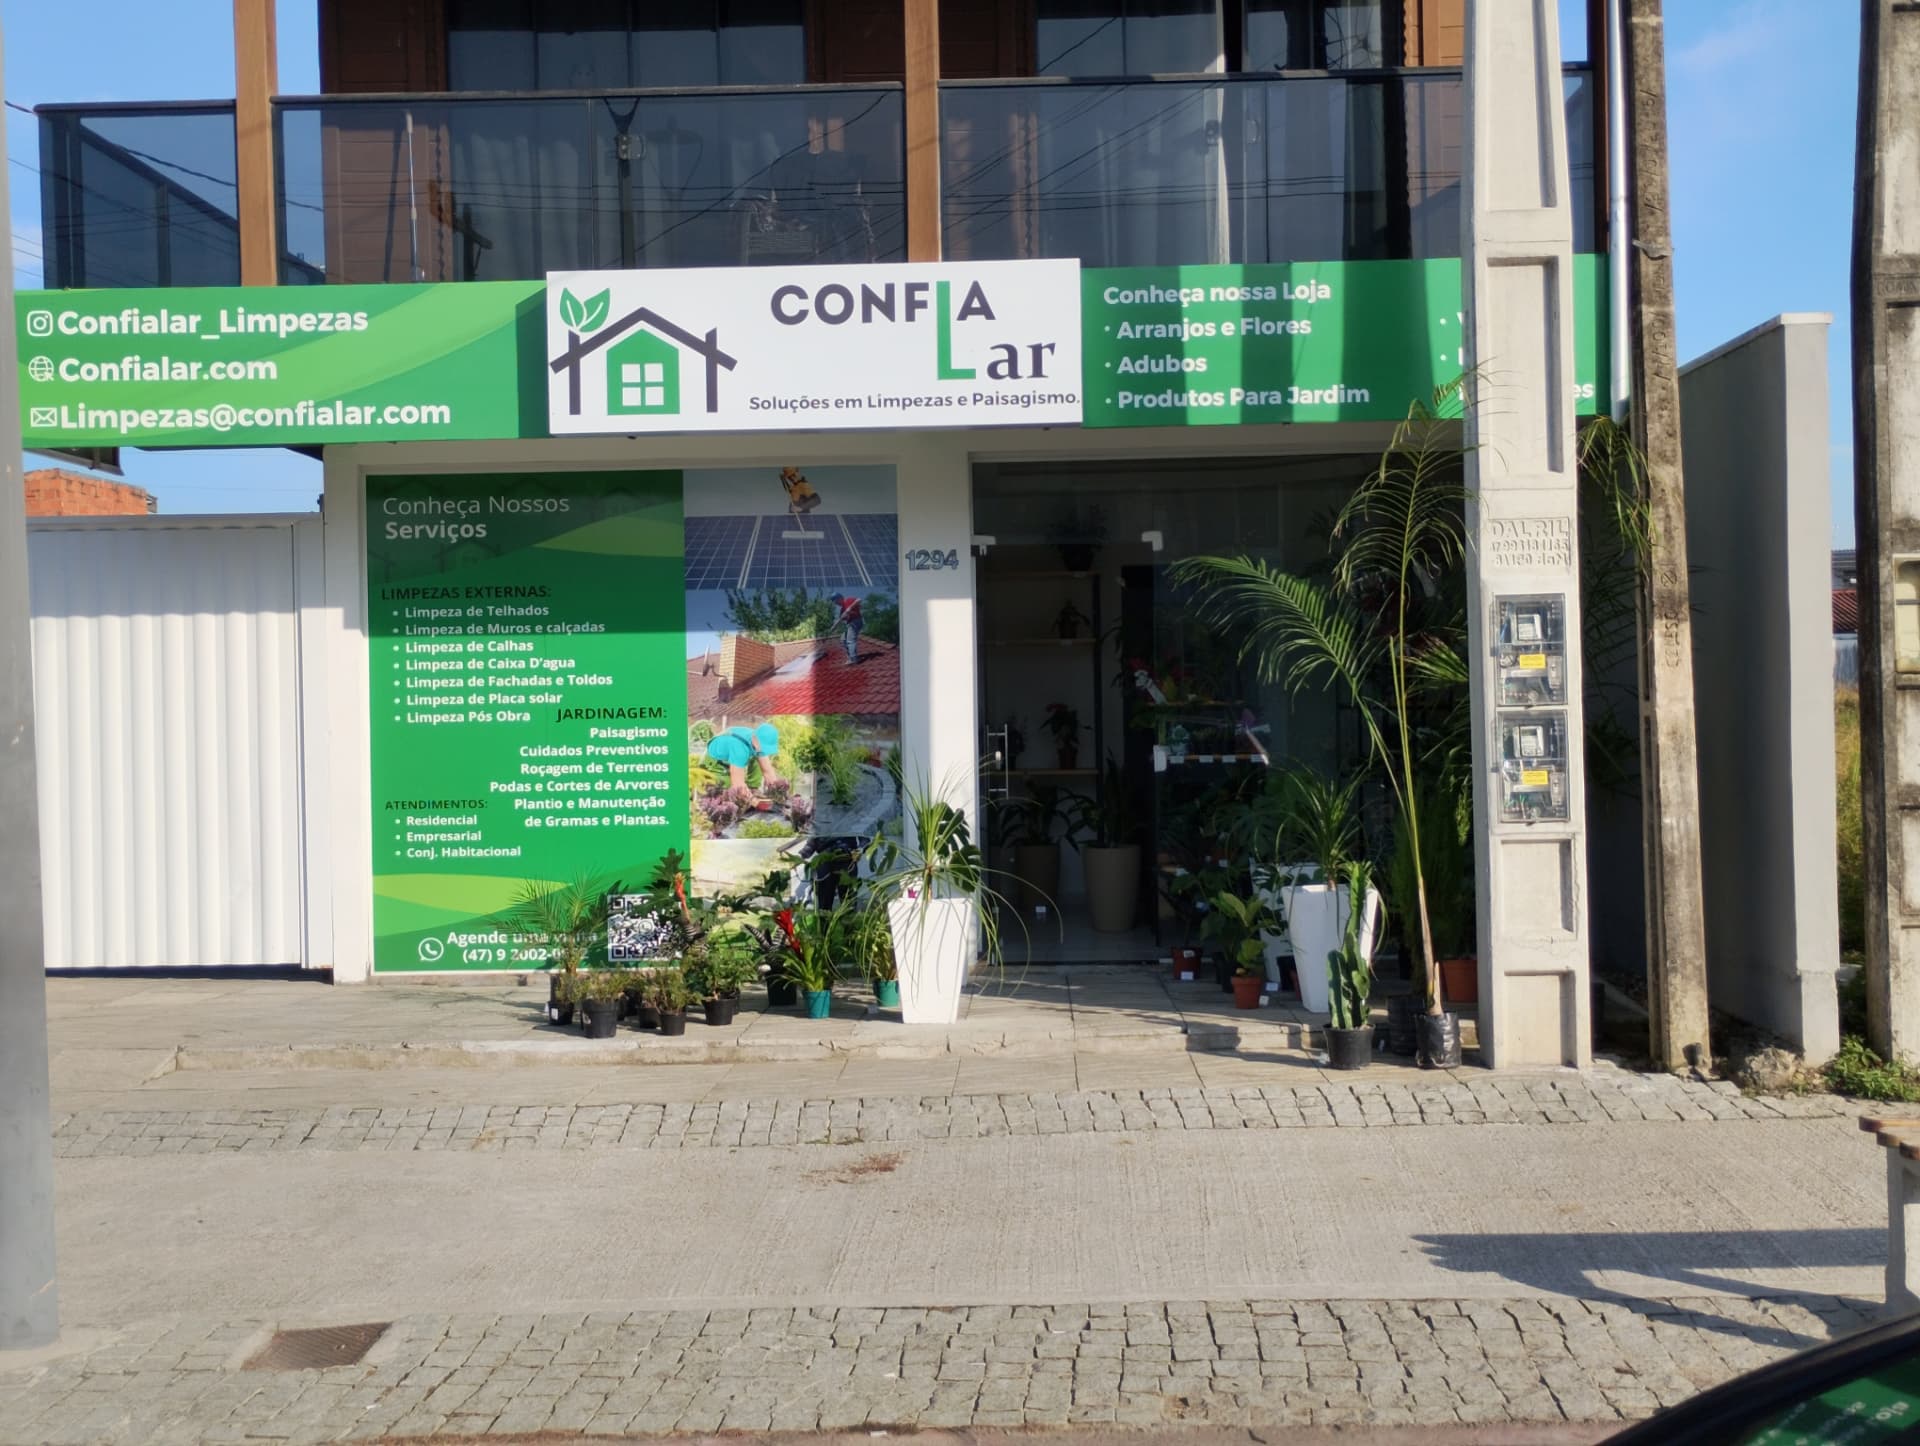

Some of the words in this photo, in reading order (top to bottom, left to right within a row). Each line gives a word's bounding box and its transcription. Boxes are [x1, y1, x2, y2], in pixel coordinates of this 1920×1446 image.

[1104, 285, 1205, 306] Conheça
[1210, 282, 1276, 302] nossa
[1283, 280, 1331, 302] Loja
[57, 307, 368, 340] Confialar_Limpezas
[1117, 320, 1216, 342] Arranjos
[1221, 319, 1235, 337] e
[1241, 316, 1311, 336] Flores
[59, 356, 277, 383] Confialar.com
[1117, 355, 1208, 375] Adubos
[749, 396, 830, 414] Soluções
[834, 397, 863, 409] em
[867, 393, 953, 412] Limpezas
[957, 395, 968, 406] e
[972, 389, 1081, 409] Paisagismo.
[1118, 390, 1225, 409] Produtos
[1230, 387, 1282, 406] Para
[1286, 385, 1370, 404] Jardim
[60, 401, 451, 434] Limpezas@confialar.com
[383, 496, 480, 518] Conheça
[489, 496, 570, 513] Nossos
[385, 520, 487, 543] Serviços
[905, 549, 959, 571] 1294
[382, 587, 460, 600] LIMPEZAS
[465, 585, 551, 598] EXTERNAS:
[405, 607, 462, 619] Limpeza
[466, 606, 483, 616] de
[486, 605, 549, 616] Telhados
[405, 624, 463, 637] Limpeza
[467, 623, 484, 634] de
[487, 623, 531, 633] Muros
[535, 624, 543, 633] e
[547, 622, 605, 635] calçadas
[406, 642, 463, 654] Limpeza
[467, 641, 484, 651] de
[488, 641, 534, 651] Calhas
[406, 659, 463, 672] Limpeza
[468, 658, 484, 669] de
[488, 658, 525, 669] Caixa
[406, 677, 464, 689] Limpeza
[468, 676, 485, 687] de
[488, 675, 552, 686] Fachadas
[555, 677, 564, 685] e
[567, 674, 613, 685] Toldos
[407, 694, 464, 707] Limpeza
[468, 694, 485, 705] de
[489, 693, 525, 704] Placa
[529, 693, 563, 704] solar
[407, 712, 464, 724] Limpeza
[469, 710, 492, 722] Pós
[496, 711, 530, 721] Obra
[555, 707, 667, 722] JARDINAGEM:
[590, 727, 668, 741] Paisagismo
[520, 745, 582, 757] Cuidados
[586, 744, 668, 756] Preventivos
[521, 763, 583, 777] Roçagem
[586, 762, 603, 773] de
[607, 762, 668, 773] Terrenos
[490, 781, 531, 792] Podas
[535, 782, 543, 792] e
[547, 780, 590, 792] Cortes
[594, 780, 612, 791] de
[615, 780, 669, 791] Arvores
[385, 800, 488, 810] ATENDIMENTOS:
[514, 798, 563, 810] Plantio
[567, 799, 575, 809] e
[578, 797, 665, 811] Manutenção
[406, 815, 477, 826] Residencial
[524, 816, 542, 827] de
[545, 815, 598, 827] Gramas
[602, 816, 610, 826] e
[614, 814, 669, 826] Plantas.
[406, 831, 481, 844] Empresarial
[406, 847, 438, 860] Conj.
[442, 846, 521, 858] Habitacional
[462, 948, 493, 963] (47)
[496, 948, 506, 960] 9
